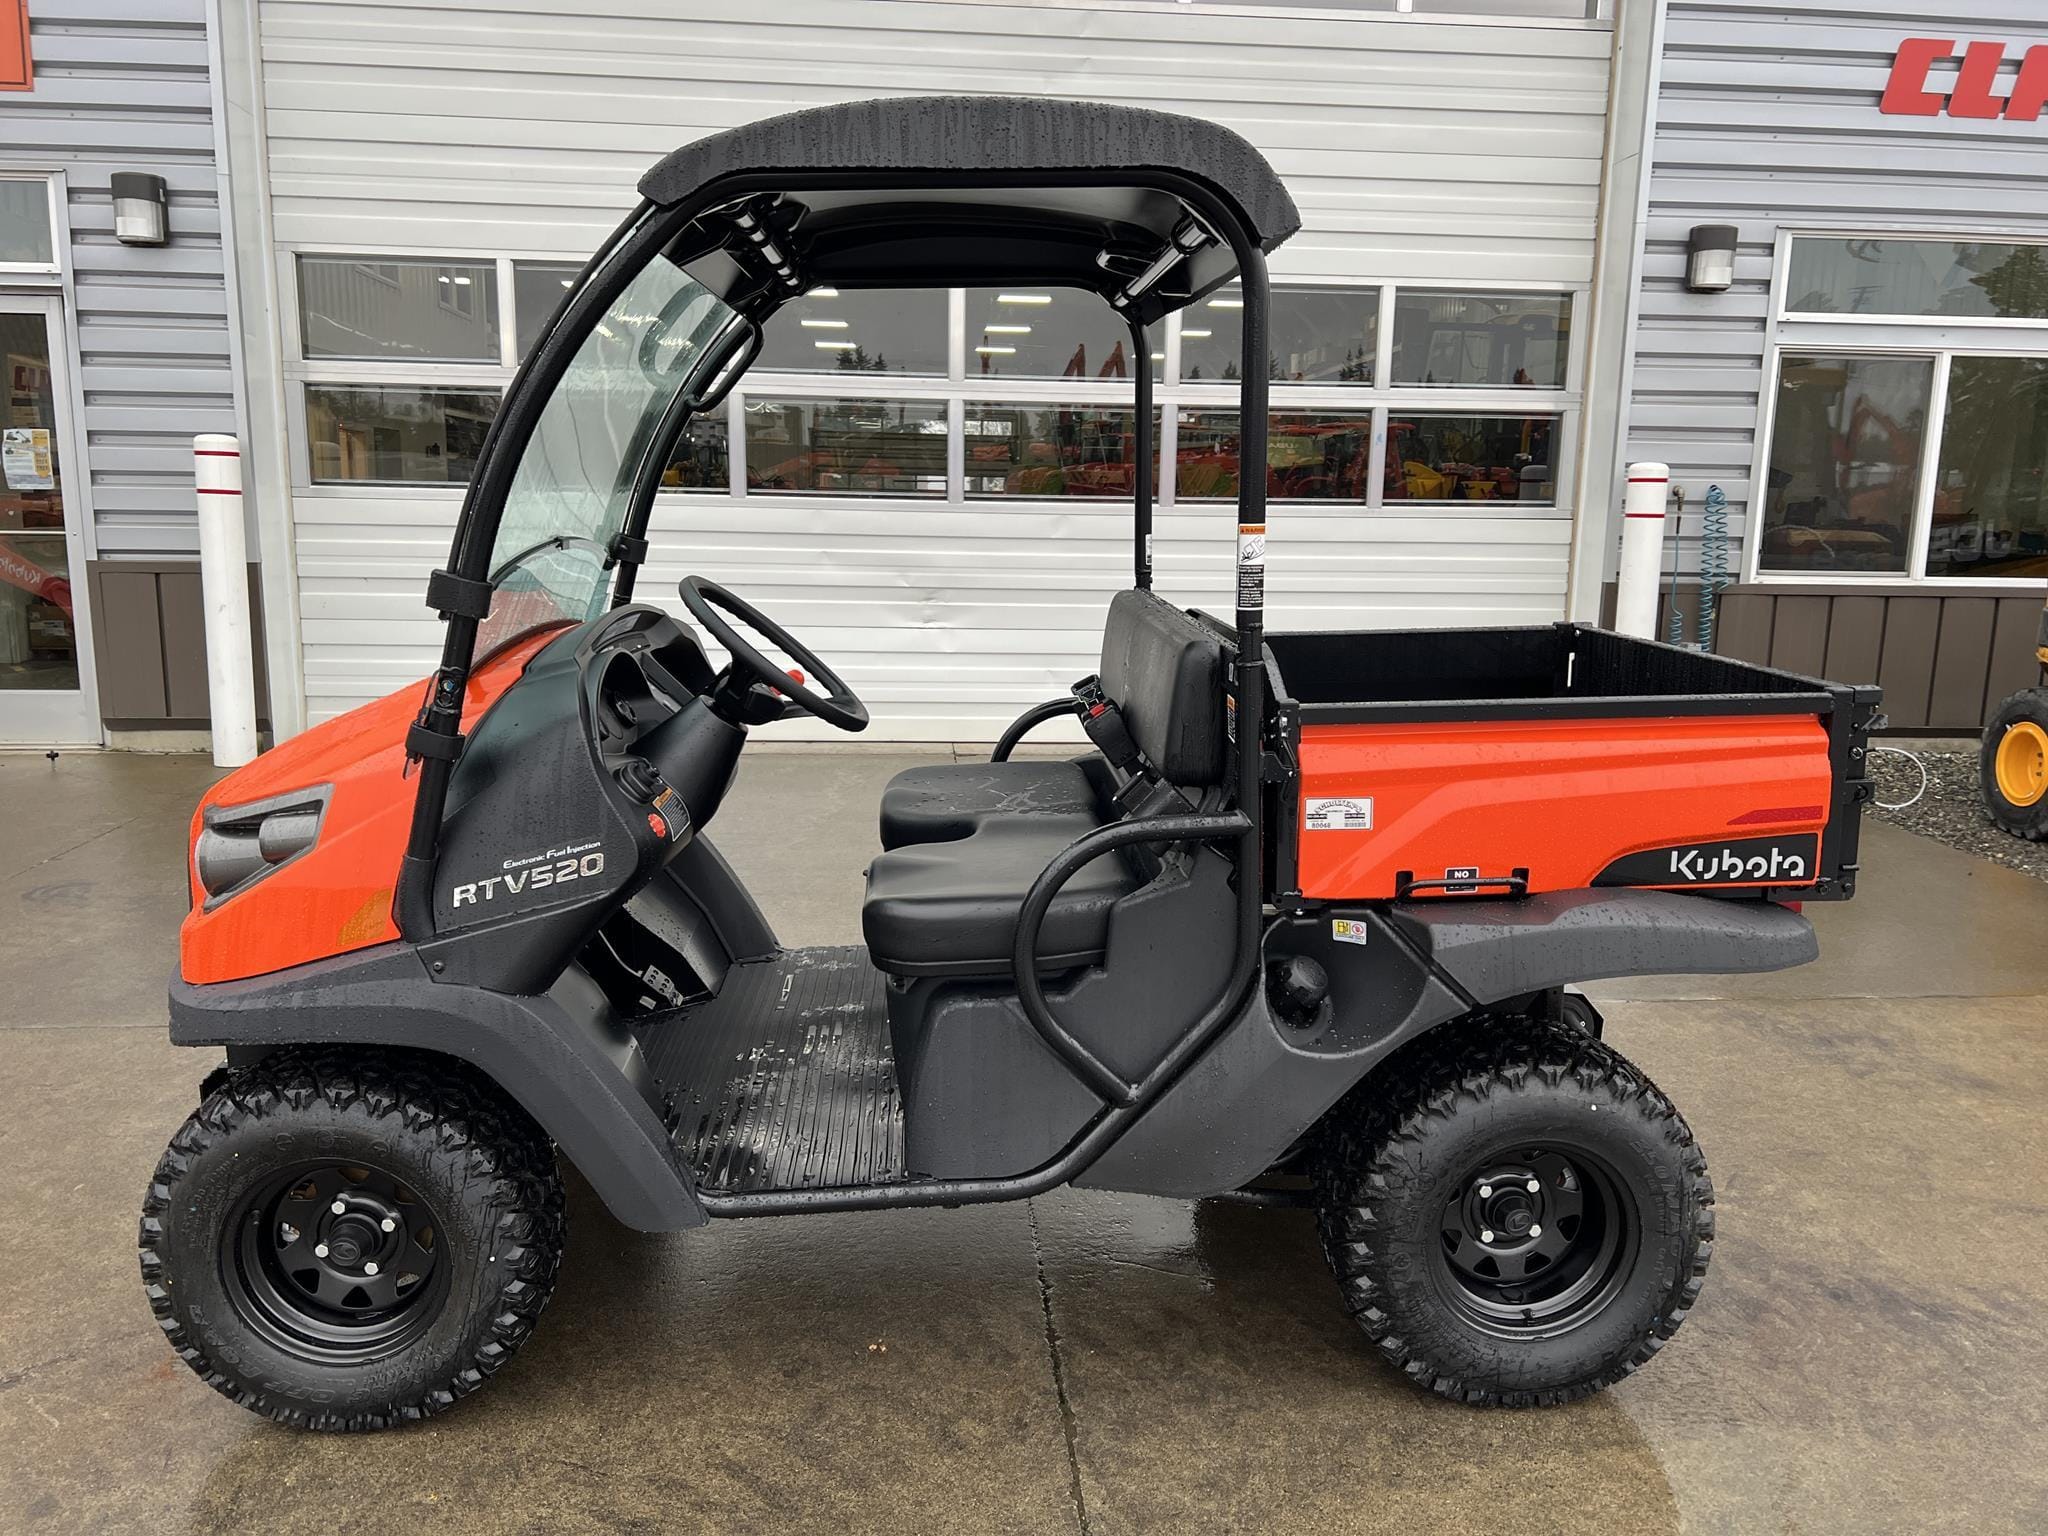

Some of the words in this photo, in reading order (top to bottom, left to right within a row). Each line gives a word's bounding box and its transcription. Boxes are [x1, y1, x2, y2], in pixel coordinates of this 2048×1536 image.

[503, 853, 545, 869] Electronic
[546, 849, 566, 861] Fuel
[567, 841, 601, 855] Injection
[1670, 848, 1805, 880] Kubota
[453, 852, 605, 908] RTV520
[1454, 870, 1470, 879] NO
